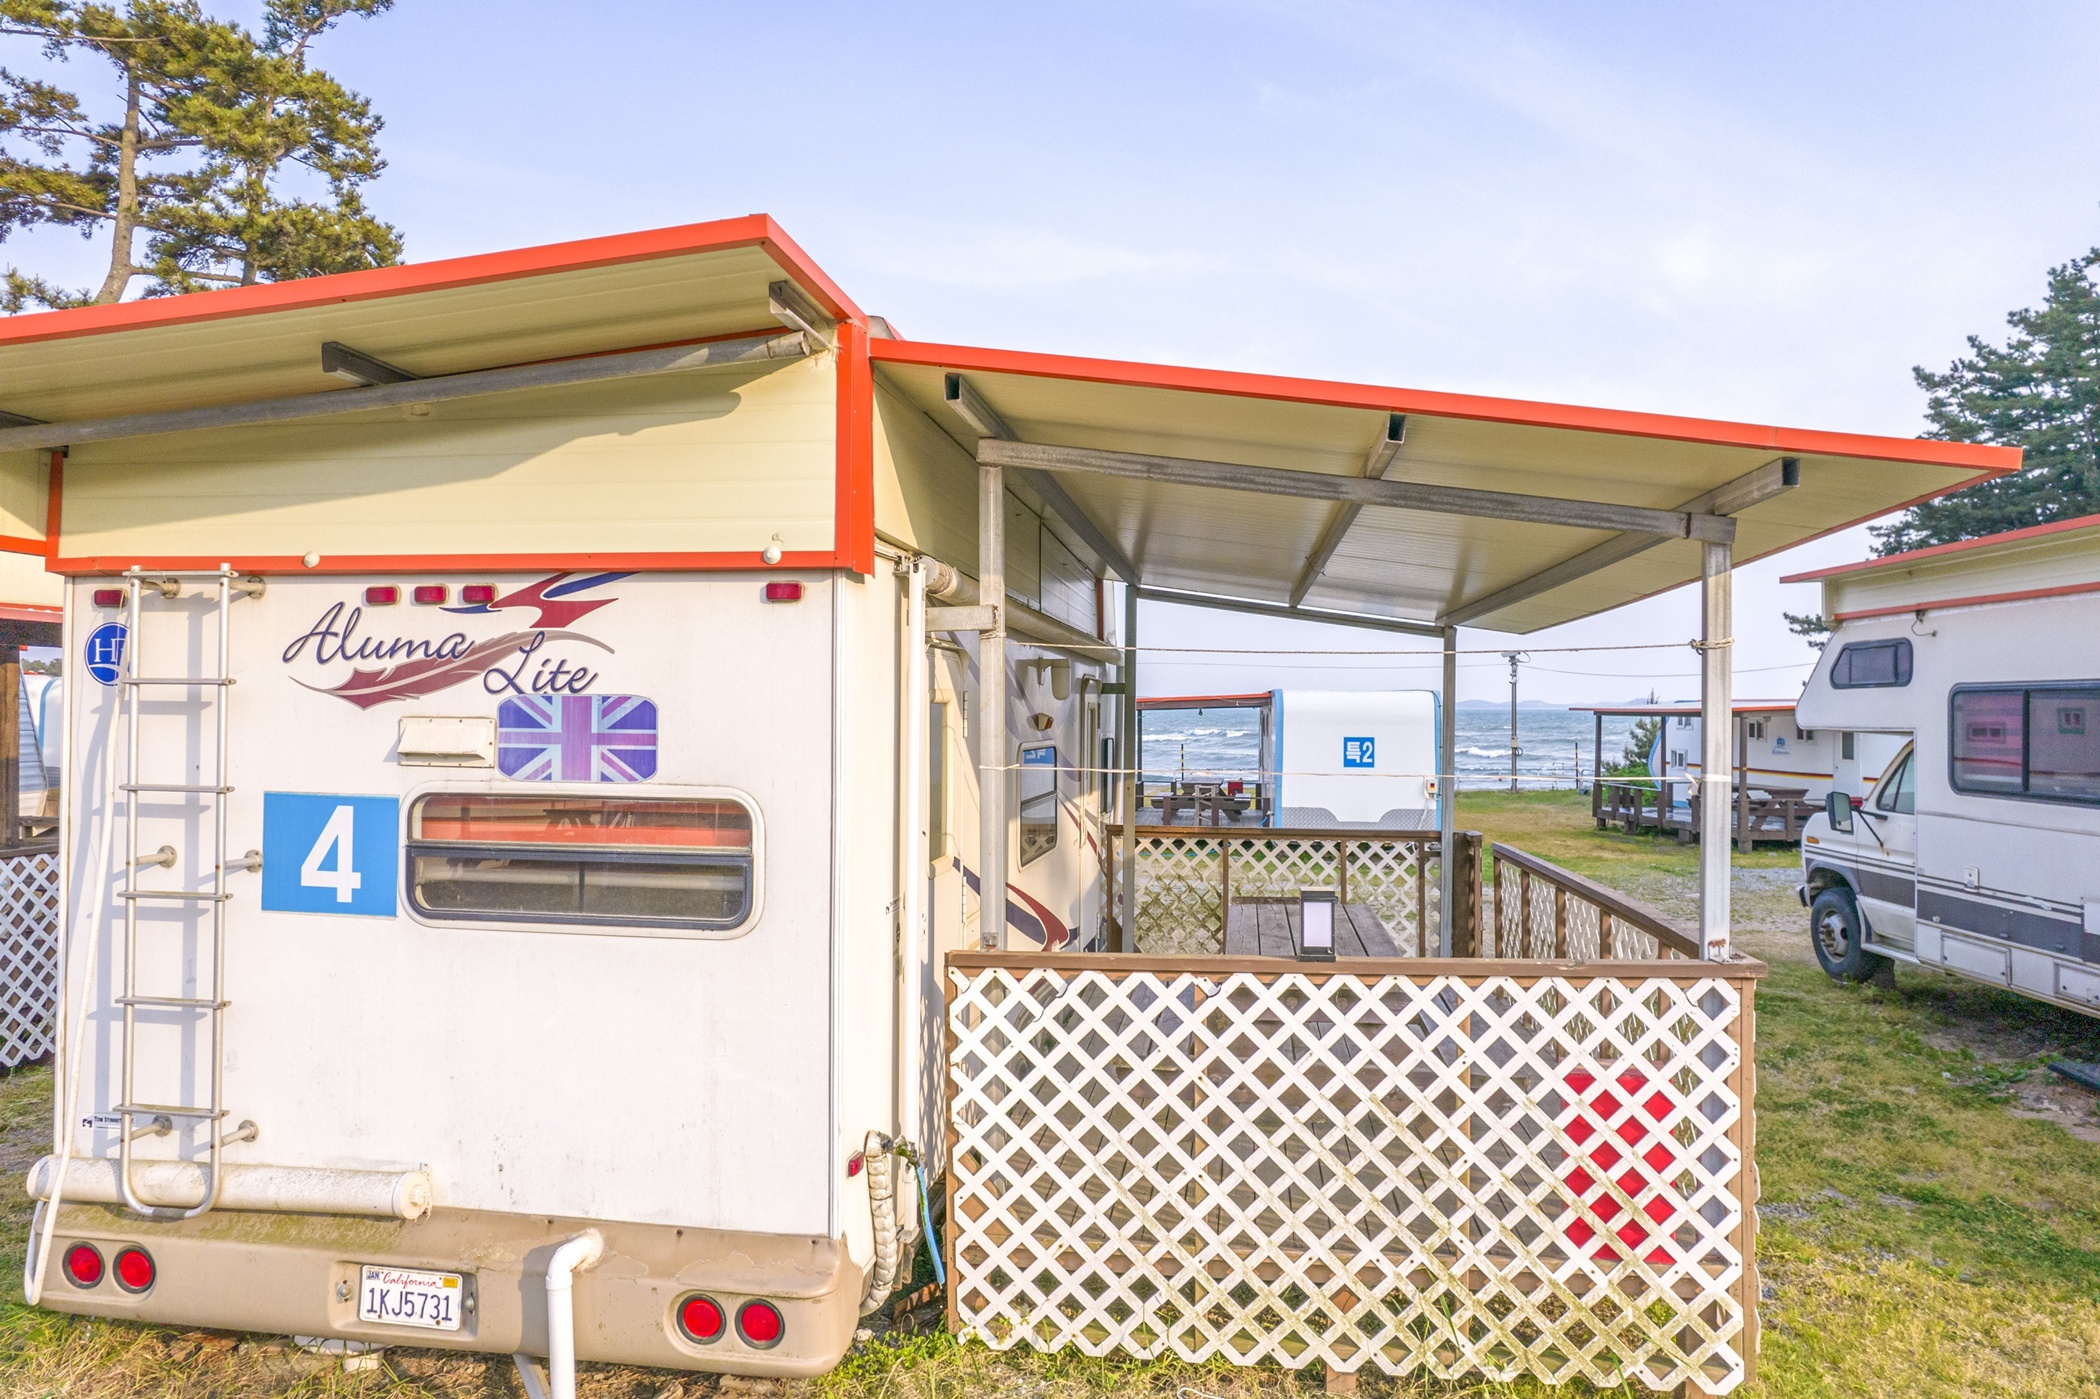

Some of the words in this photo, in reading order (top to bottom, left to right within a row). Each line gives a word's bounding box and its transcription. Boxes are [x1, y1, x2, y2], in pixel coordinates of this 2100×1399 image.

[282, 601, 474, 666] Aluma
[482, 631, 600, 697] Lite
[1346, 741, 1373, 763] 특2
[300, 805, 361, 903] 4
[366, 1287, 452, 1321] 1KJ5731
[382, 1271, 443, 1289] California
